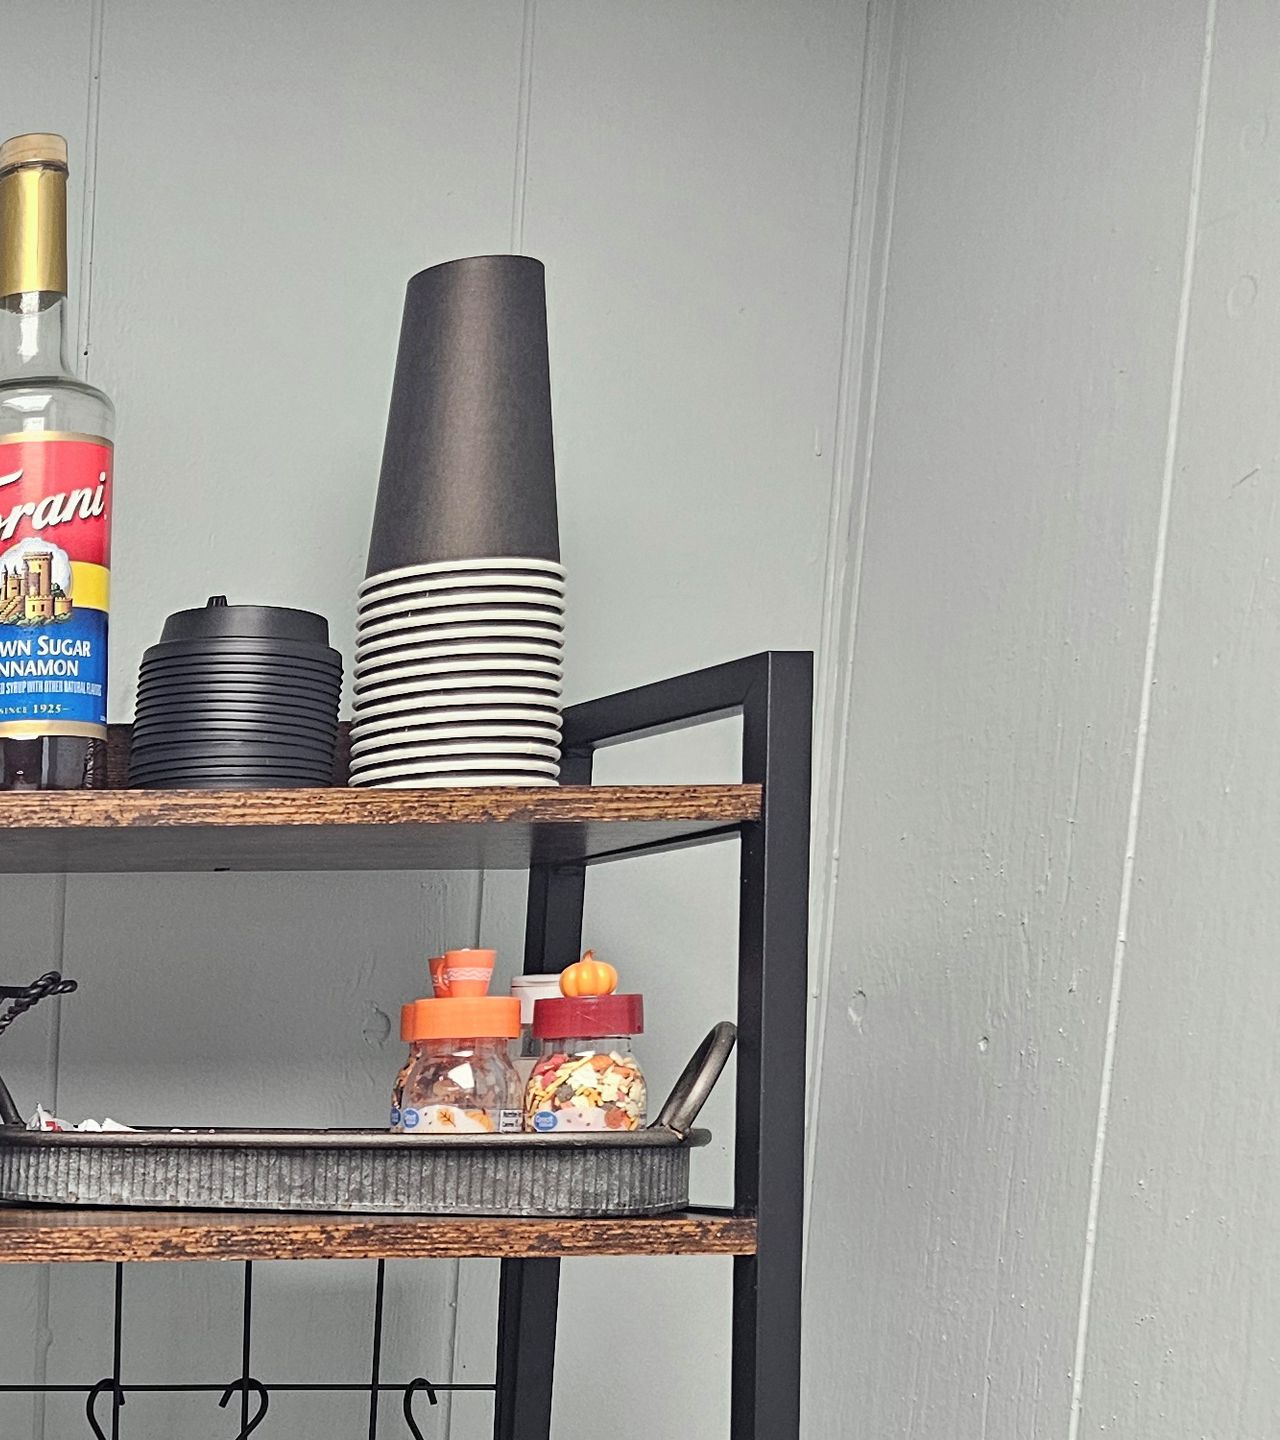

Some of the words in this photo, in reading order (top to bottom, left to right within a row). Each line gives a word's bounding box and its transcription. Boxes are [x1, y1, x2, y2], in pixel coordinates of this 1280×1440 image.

[37, 635, 91, 657] SUGAR
[0, 706, 28, 714] SINCE
[32, 704, 62, 714] 1925
